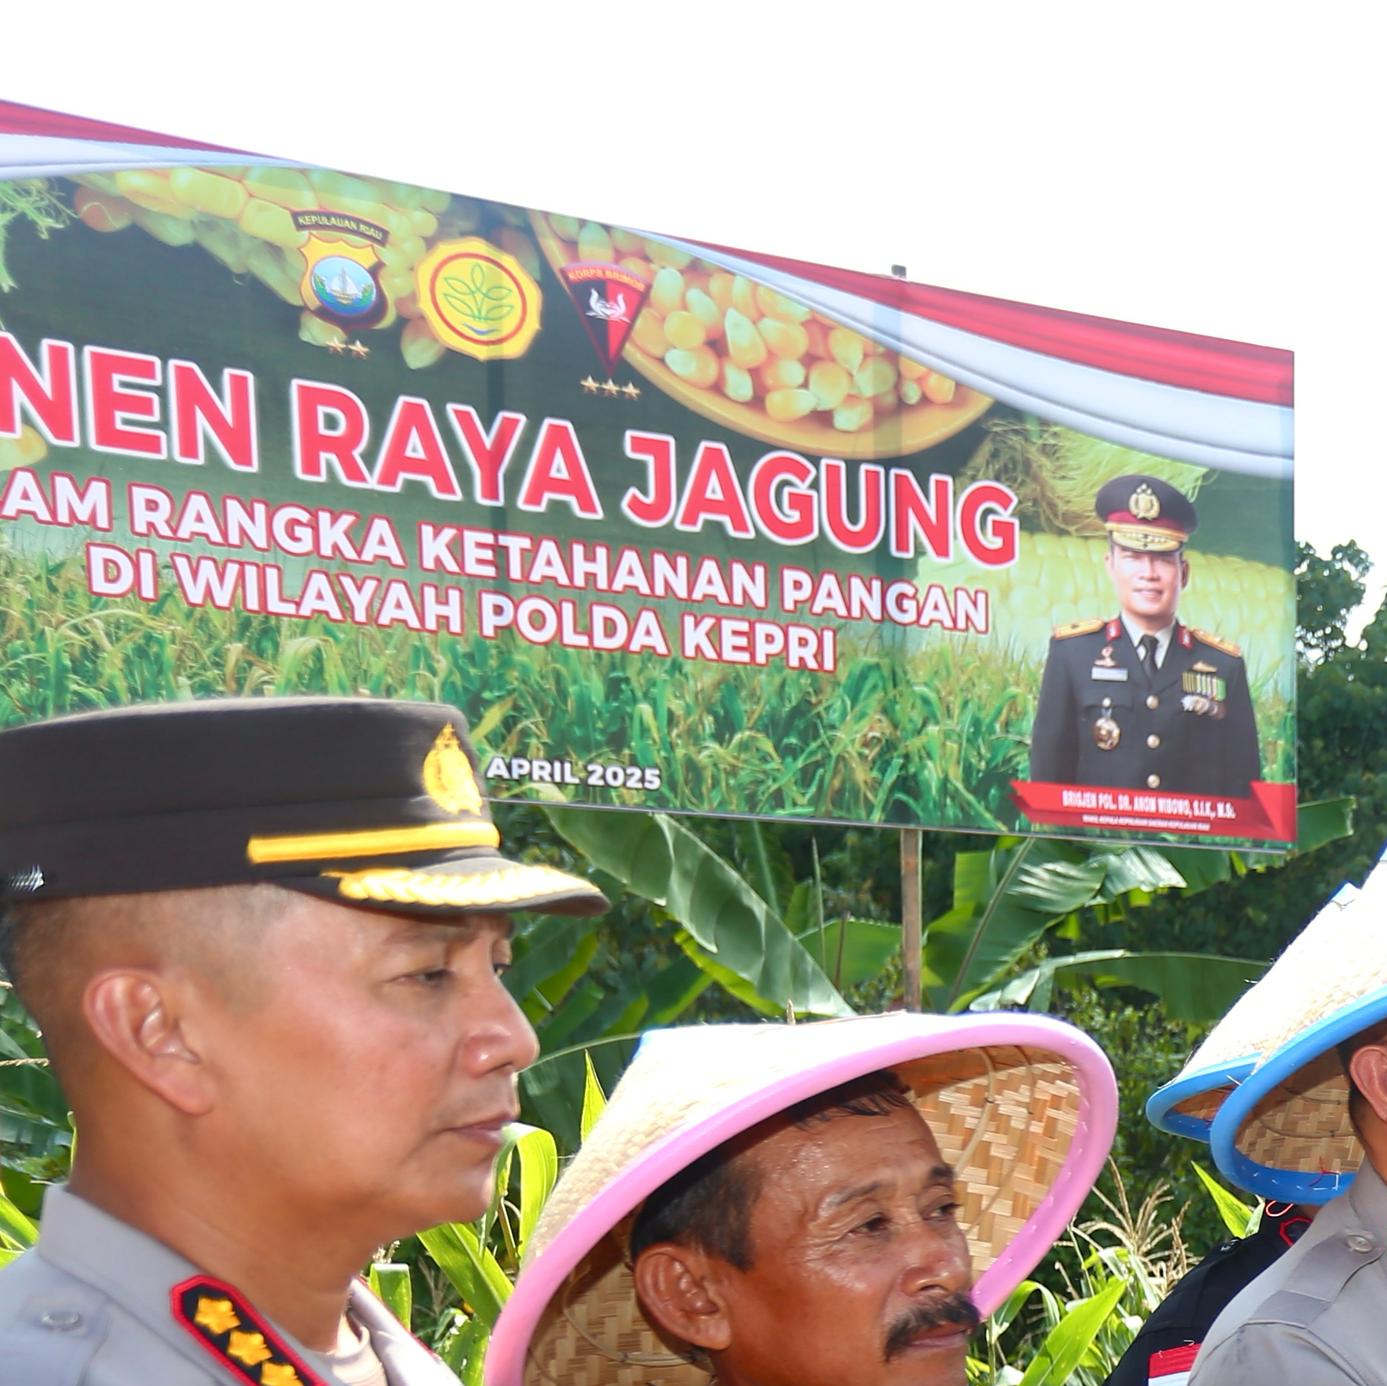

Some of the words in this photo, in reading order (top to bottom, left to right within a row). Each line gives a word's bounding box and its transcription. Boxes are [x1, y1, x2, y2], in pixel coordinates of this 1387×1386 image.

[290, 378, 604, 520] RAYA
[621, 429, 1019, 569] JAGUNG
[1, 468, 113, 532] AM
[130, 483, 405, 568] RANGKA
[418, 520, 768, 611] KETAHANAN
[782, 567, 990, 634] PANGAN
[86, 541, 159, 600] DI
[171, 552, 464, 637] WILAYAH
[479, 592, 670, 658] POLDA
[682, 618, 837, 675] KEPRI
[485, 755, 579, 787] APRIL
[586, 762, 662, 791] 2025
